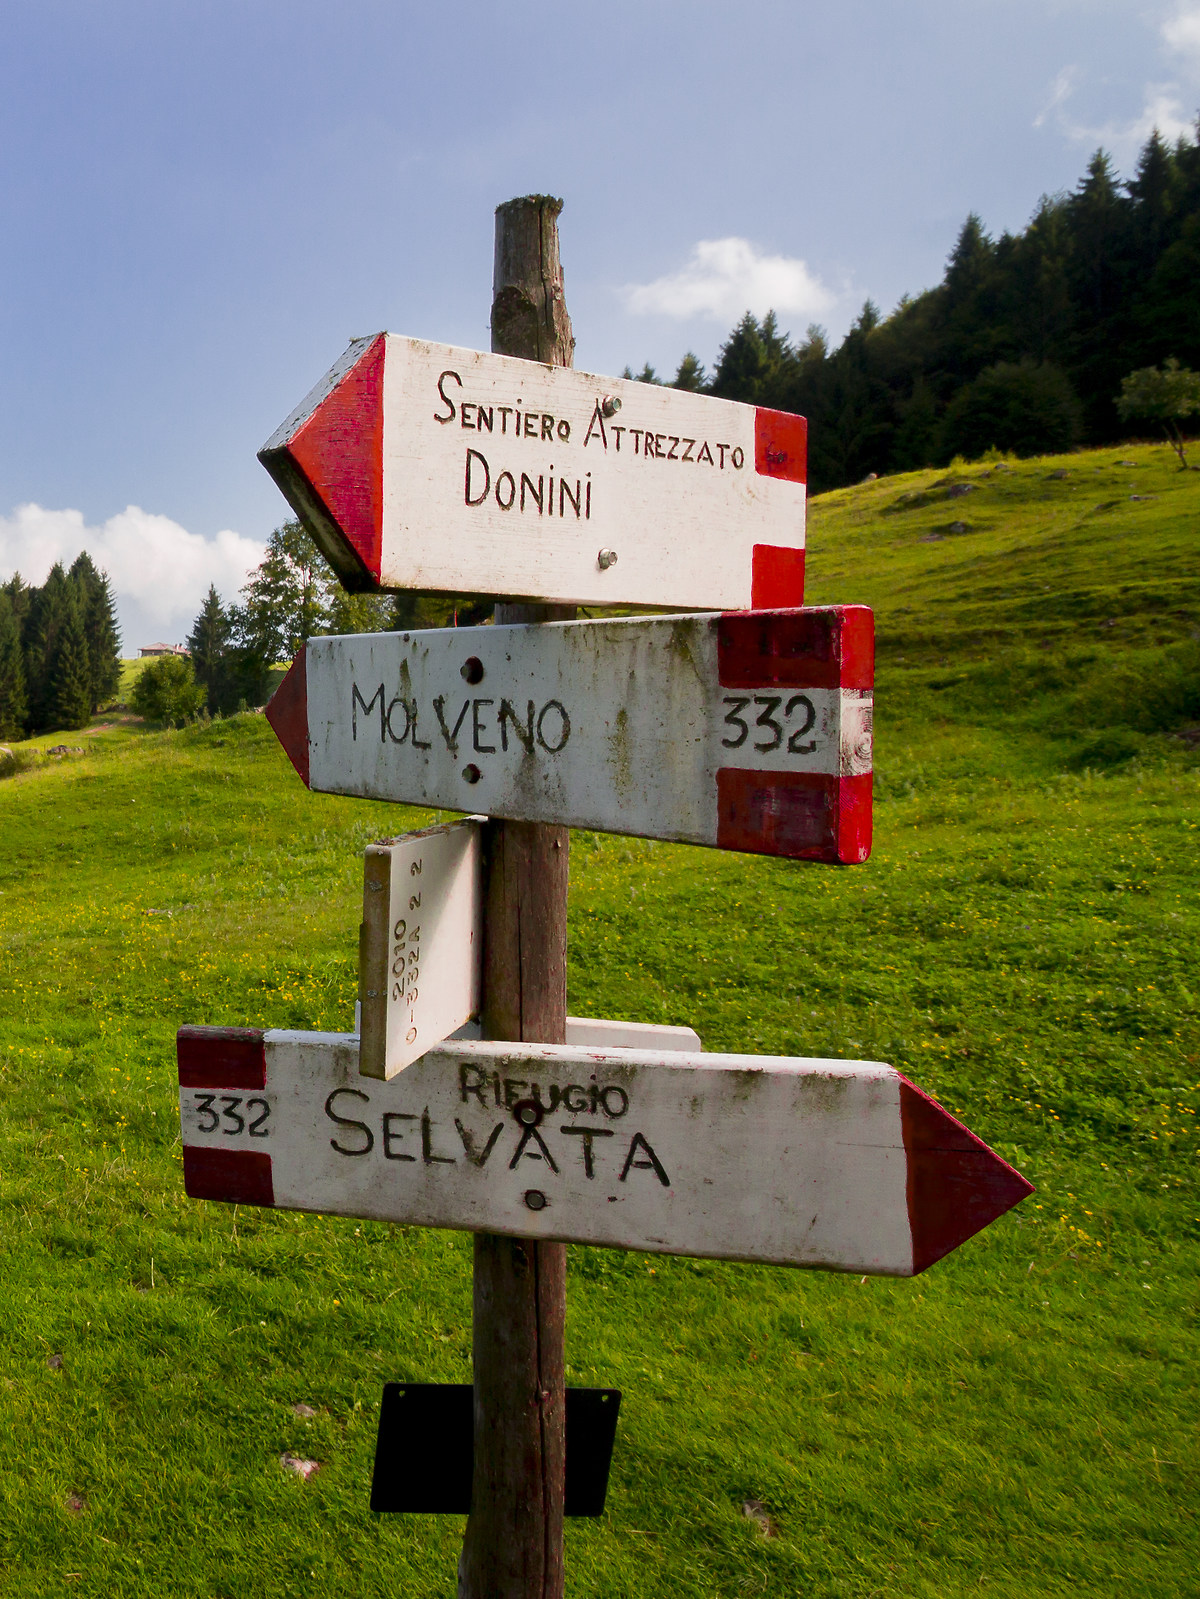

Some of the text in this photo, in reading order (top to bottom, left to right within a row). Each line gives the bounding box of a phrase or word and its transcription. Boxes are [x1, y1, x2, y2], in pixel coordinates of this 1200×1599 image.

[433, 370, 745, 470] SENTIERO ATTREZZATO
[464, 448, 593, 520] DONINI
[350, 682, 571, 755] MOLVENO
[721, 694, 818, 755] 332
[392, 919, 407, 1002] 2010
[193, 1093, 272, 1138] 332
[324, 1087, 670, 1187] SELVATA
